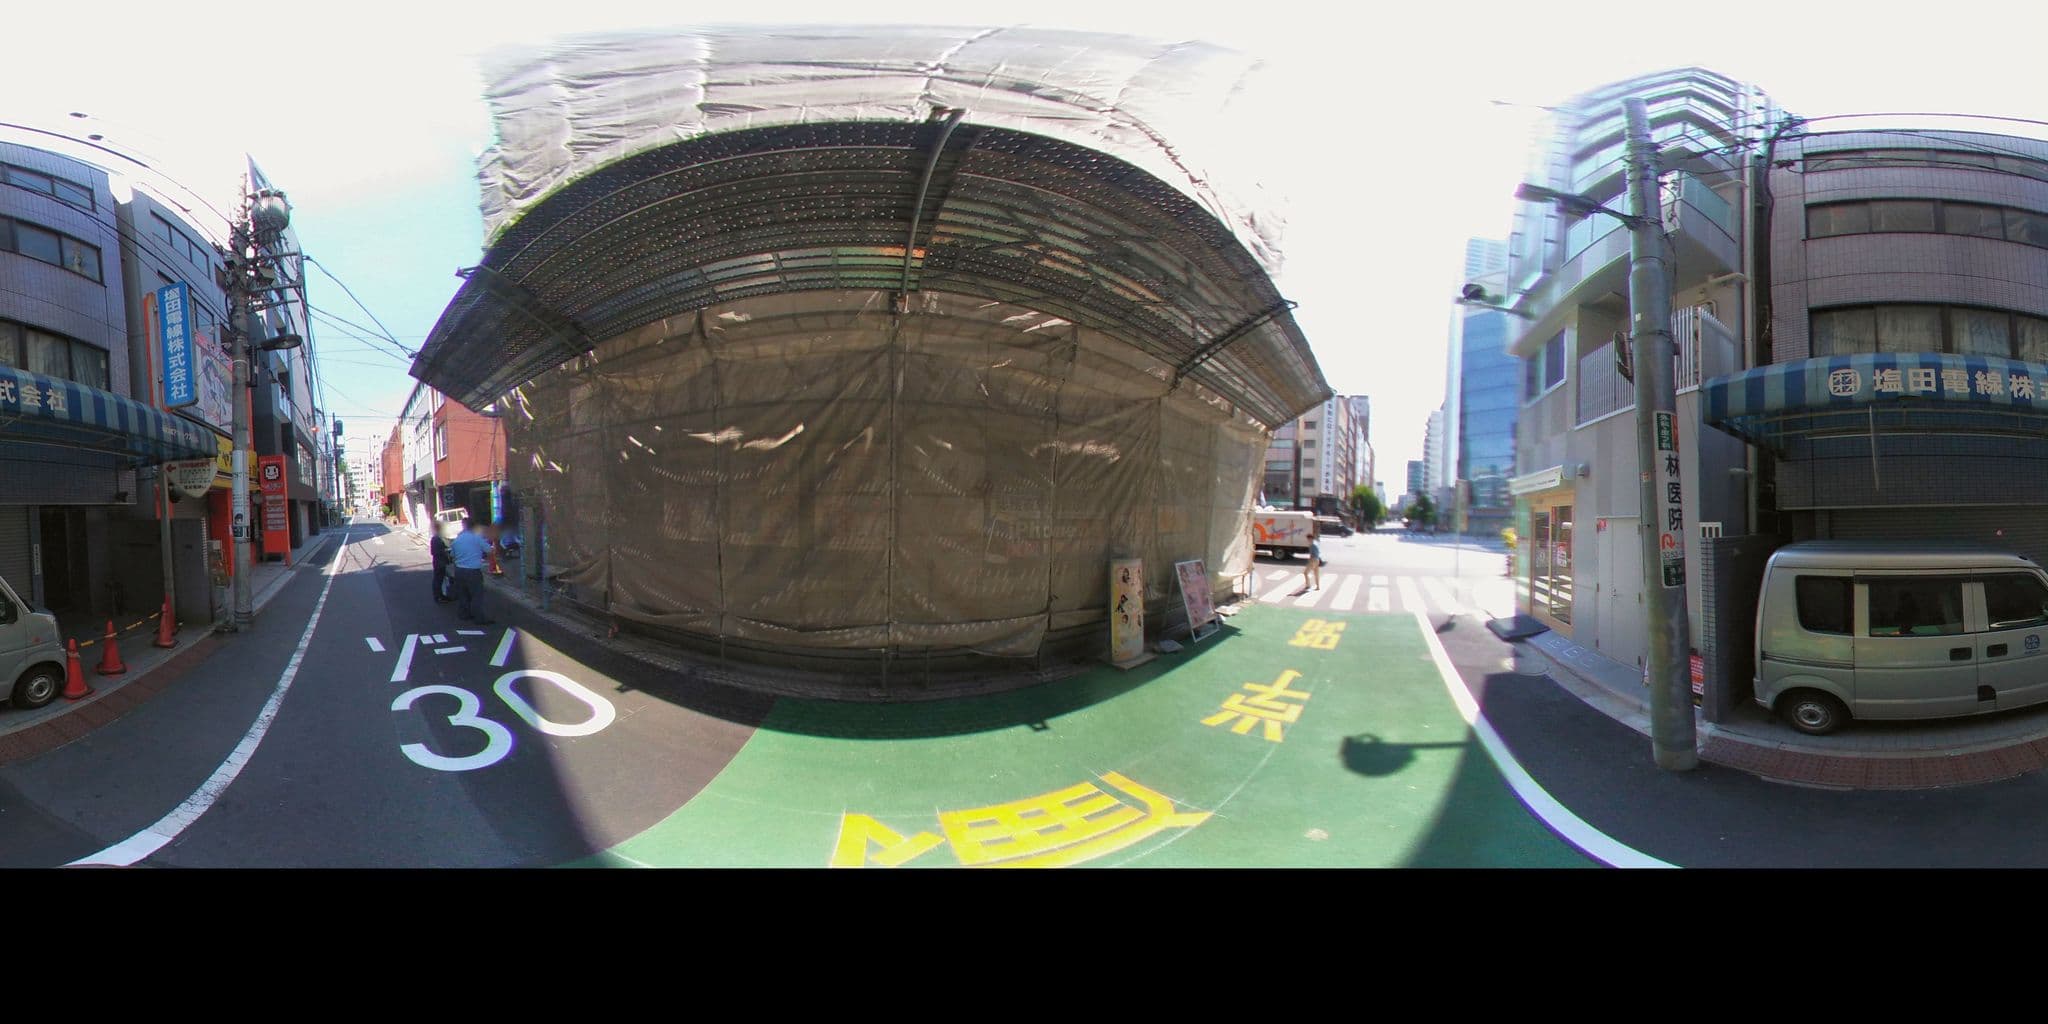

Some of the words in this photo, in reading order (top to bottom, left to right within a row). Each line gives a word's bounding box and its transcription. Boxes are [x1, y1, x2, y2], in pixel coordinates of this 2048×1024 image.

[164, 287, 188, 400] 塩田電線株式会社
[390, 669, 617, 771] 30
